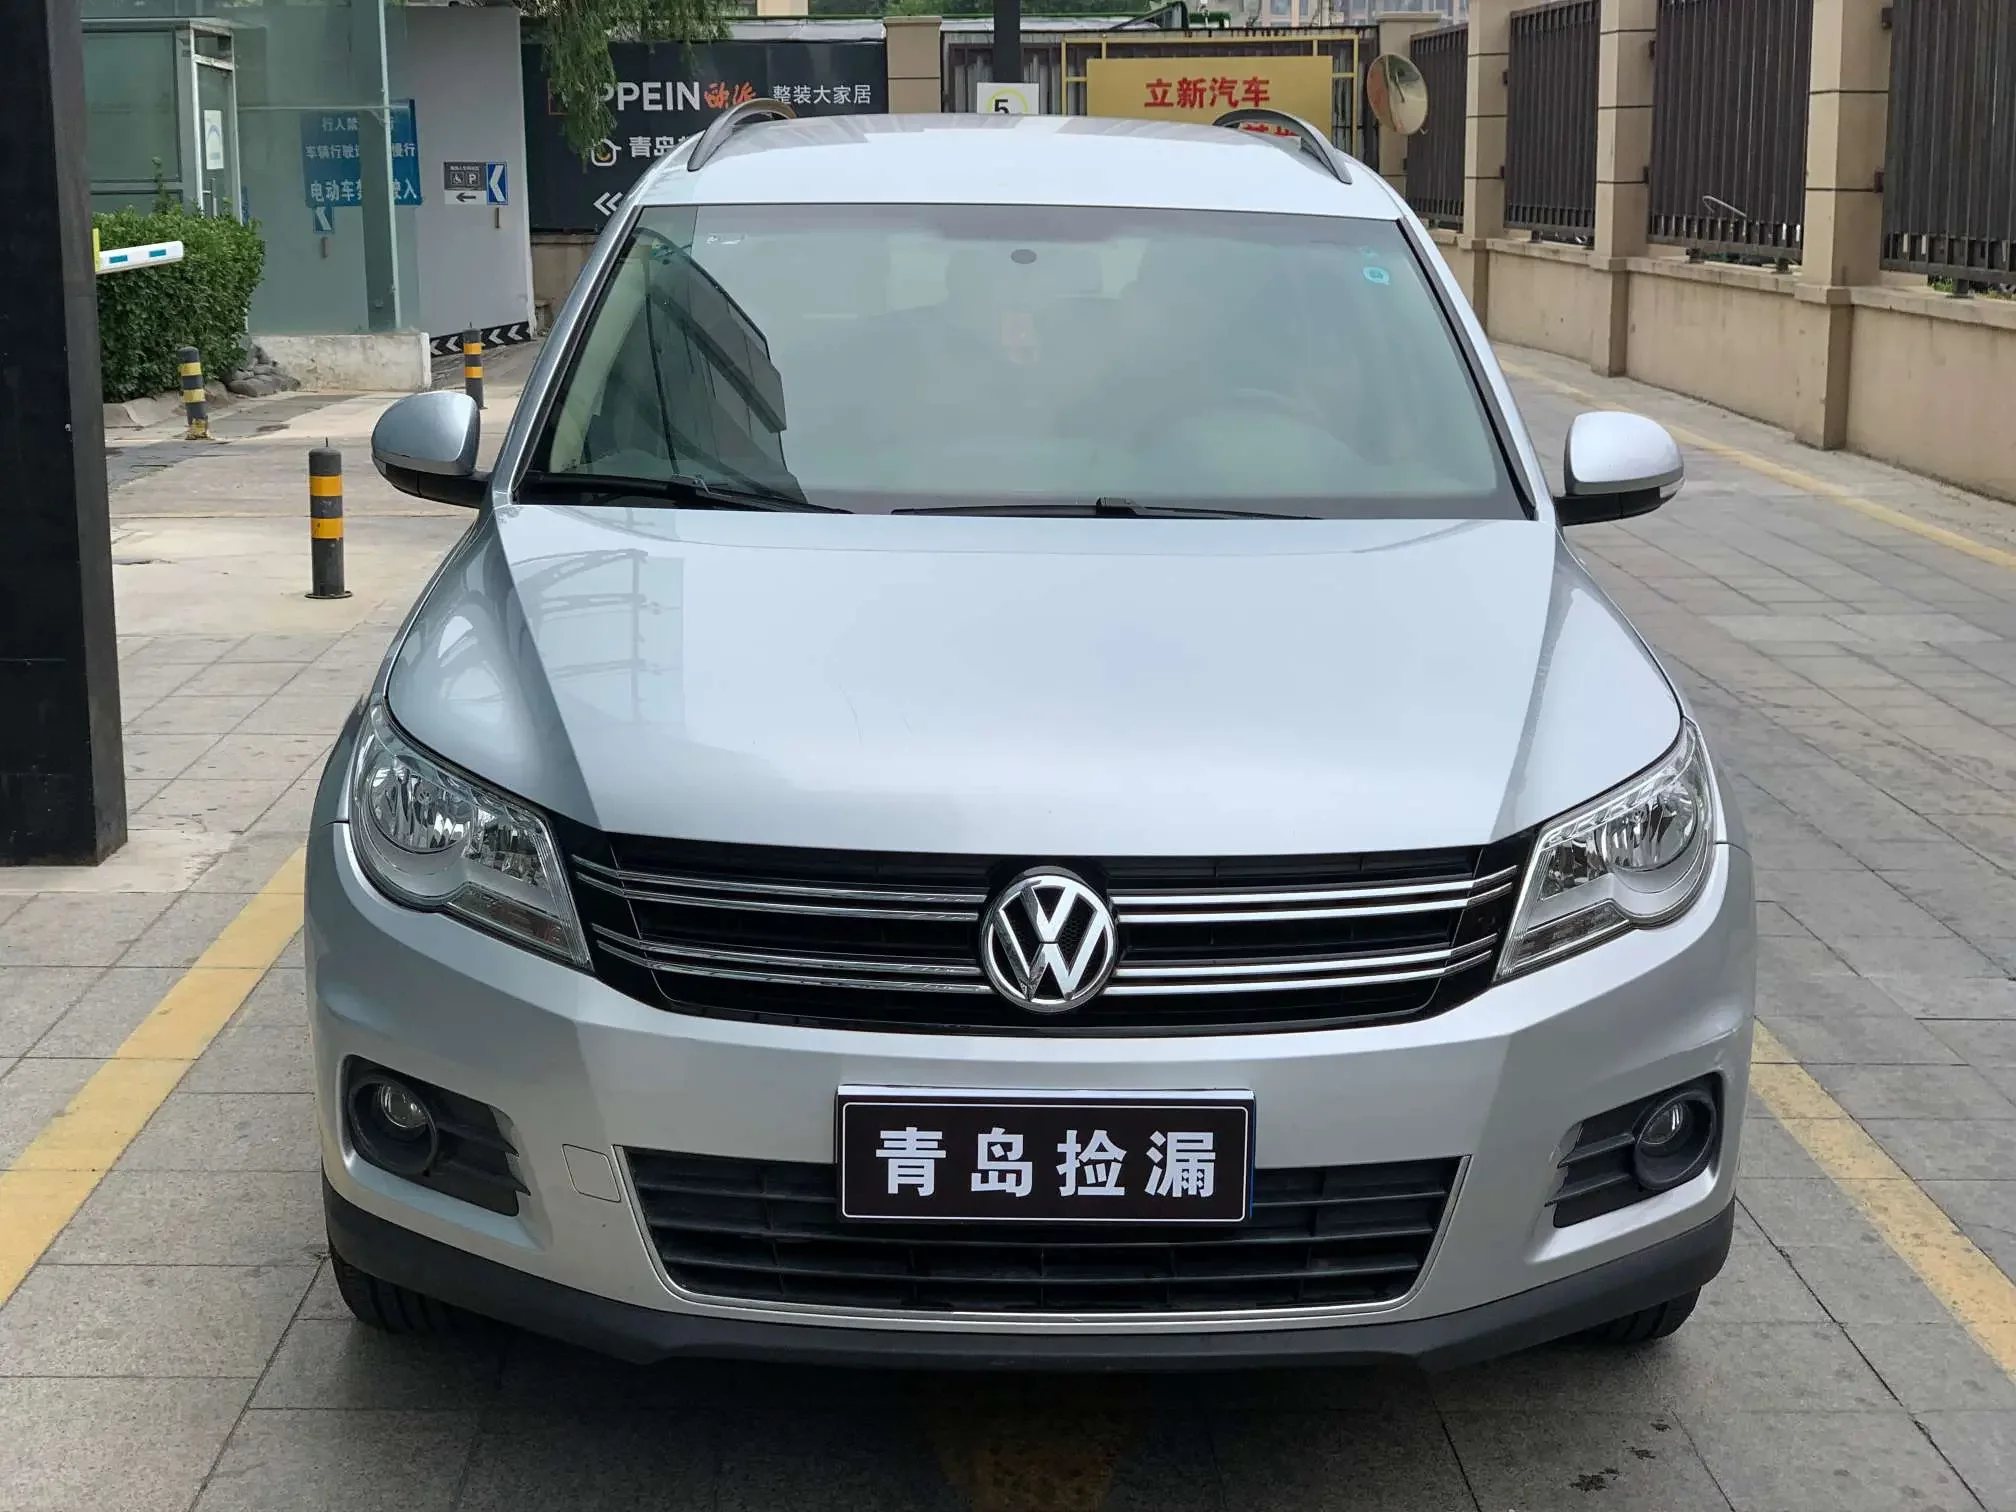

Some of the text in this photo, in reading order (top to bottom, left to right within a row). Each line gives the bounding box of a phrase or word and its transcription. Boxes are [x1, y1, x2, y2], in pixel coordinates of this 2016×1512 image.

[772, 84, 872, 104] 整装大家居
[1144, 76, 1270, 109] 立新汽车
[629, 136, 687, 158] 青岛
[875, 1126, 1217, 1198] 青岛捡漏
